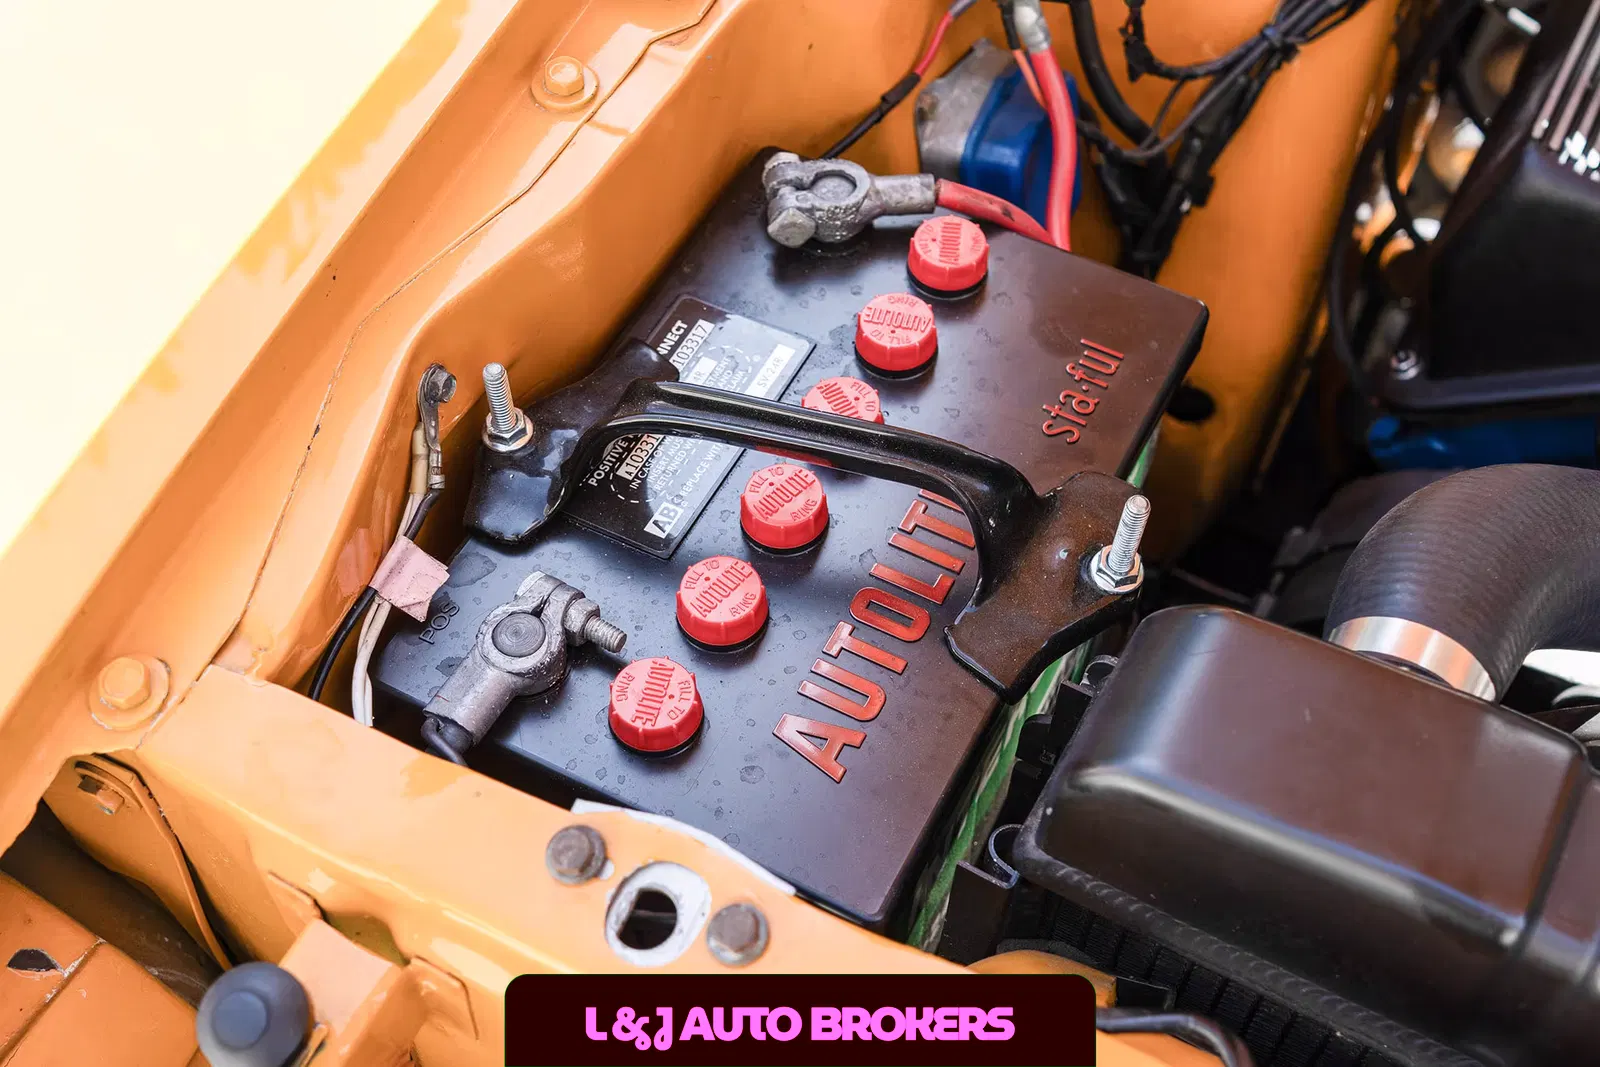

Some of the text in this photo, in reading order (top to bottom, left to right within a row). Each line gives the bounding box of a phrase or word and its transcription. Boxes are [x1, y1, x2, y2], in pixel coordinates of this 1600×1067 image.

[863, 306, 932, 333] AUTOLITE
[850, 381, 871, 399] FILL
[588, 439, 629, 487] POSITIVE
[655, 449, 688, 491] RETURNED
[679, 459, 709, 498] REPLACE
[749, 466, 785, 494] FILL TO
[753, 468, 816, 521] AUTOLITE
[789, 498, 818, 522] RING
[652, 505, 681, 534] AB
[684, 559, 720, 590] FILL TO
[690, 561, 754, 618] AUTOLITE
[419, 599, 460, 645] POS
[728, 592, 757, 617] RING
[615, 672, 636, 702] RING
[631, 660, 676, 727] AUTOLITE
[667, 680, 693, 721] FILL TO
